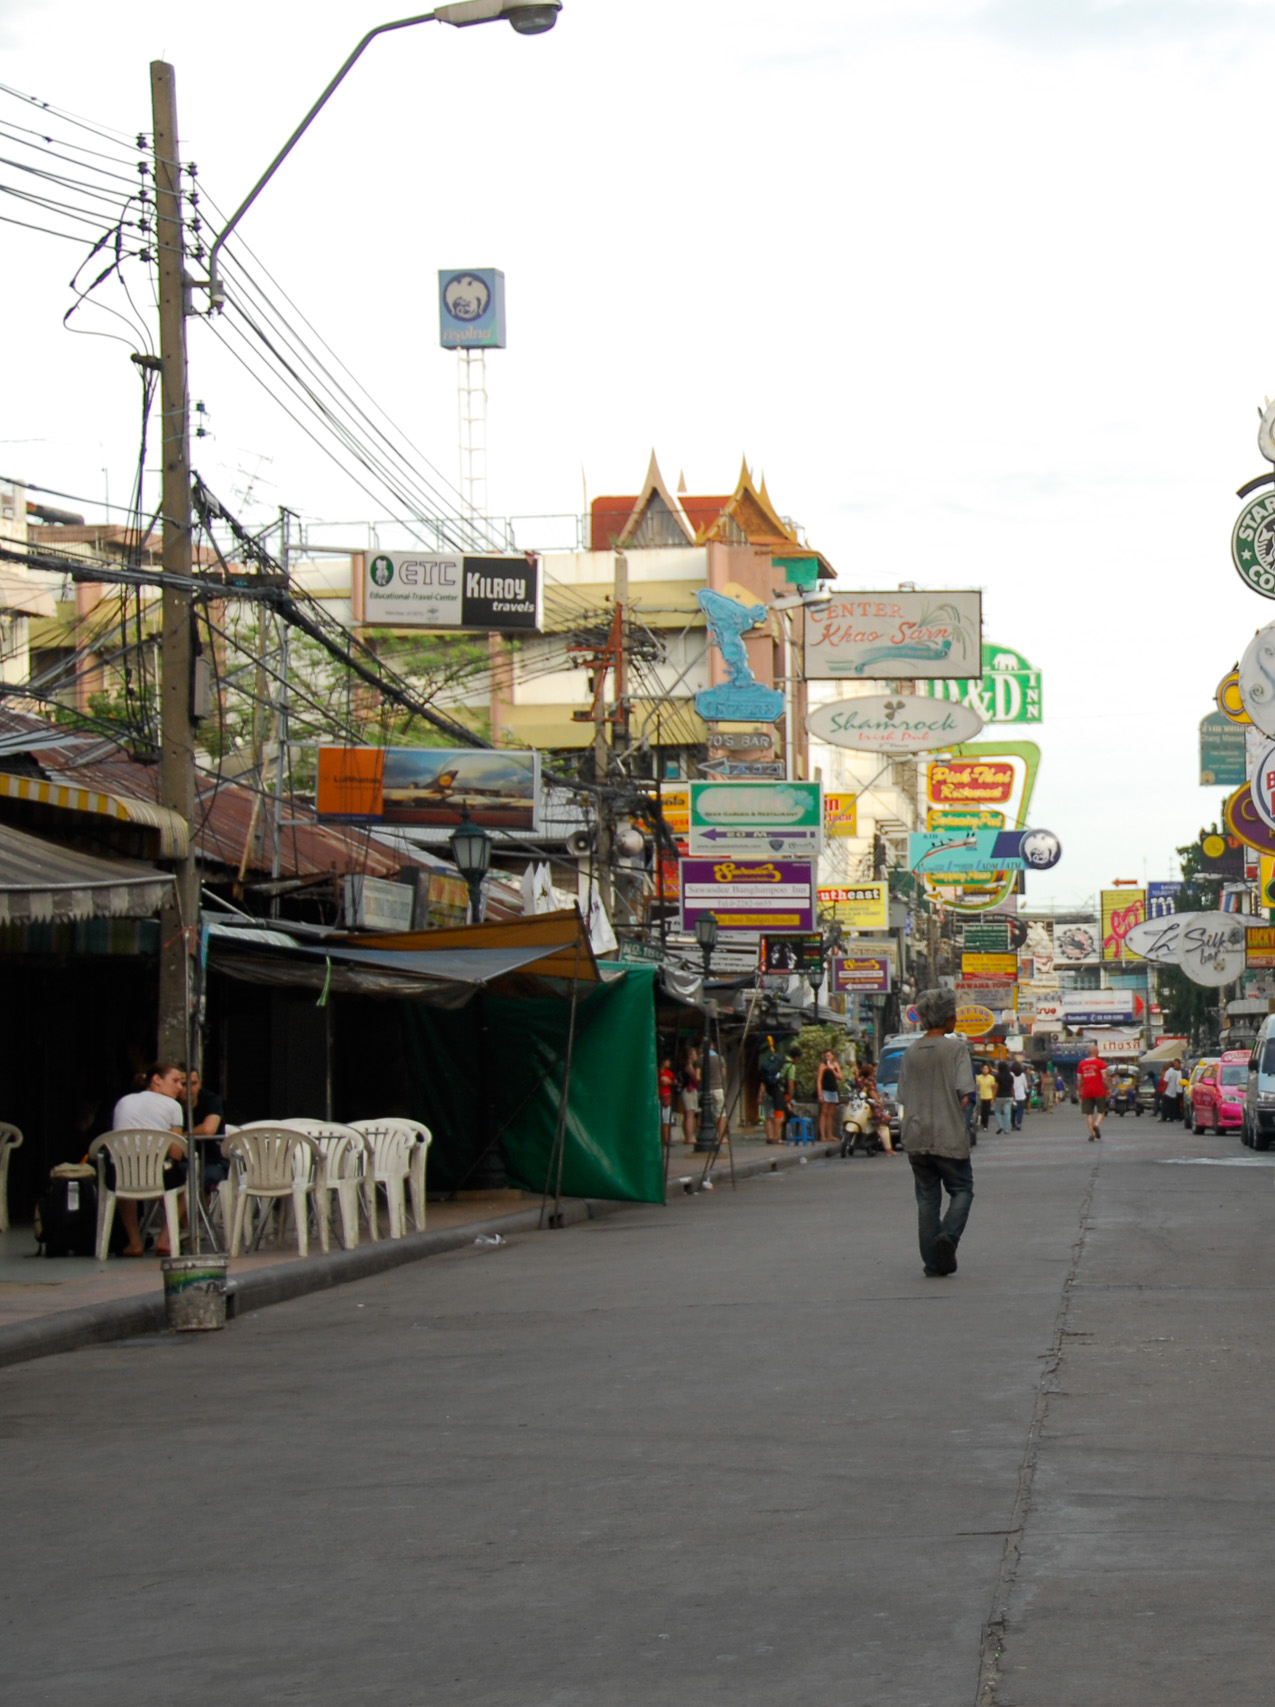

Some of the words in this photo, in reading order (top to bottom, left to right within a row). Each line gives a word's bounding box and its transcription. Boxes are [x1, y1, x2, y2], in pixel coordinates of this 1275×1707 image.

[398, 560, 457, 586] ETC
[492, 601, 535, 613] travels
[809, 622, 881, 647] Khao
[890, 621, 951, 645] Sarn
[829, 711, 959, 734] Shamrock
[741, 735, 770, 747] BAR
[688, 885, 730, 894] Sawasdee
[818, 889, 880, 901] utheast
